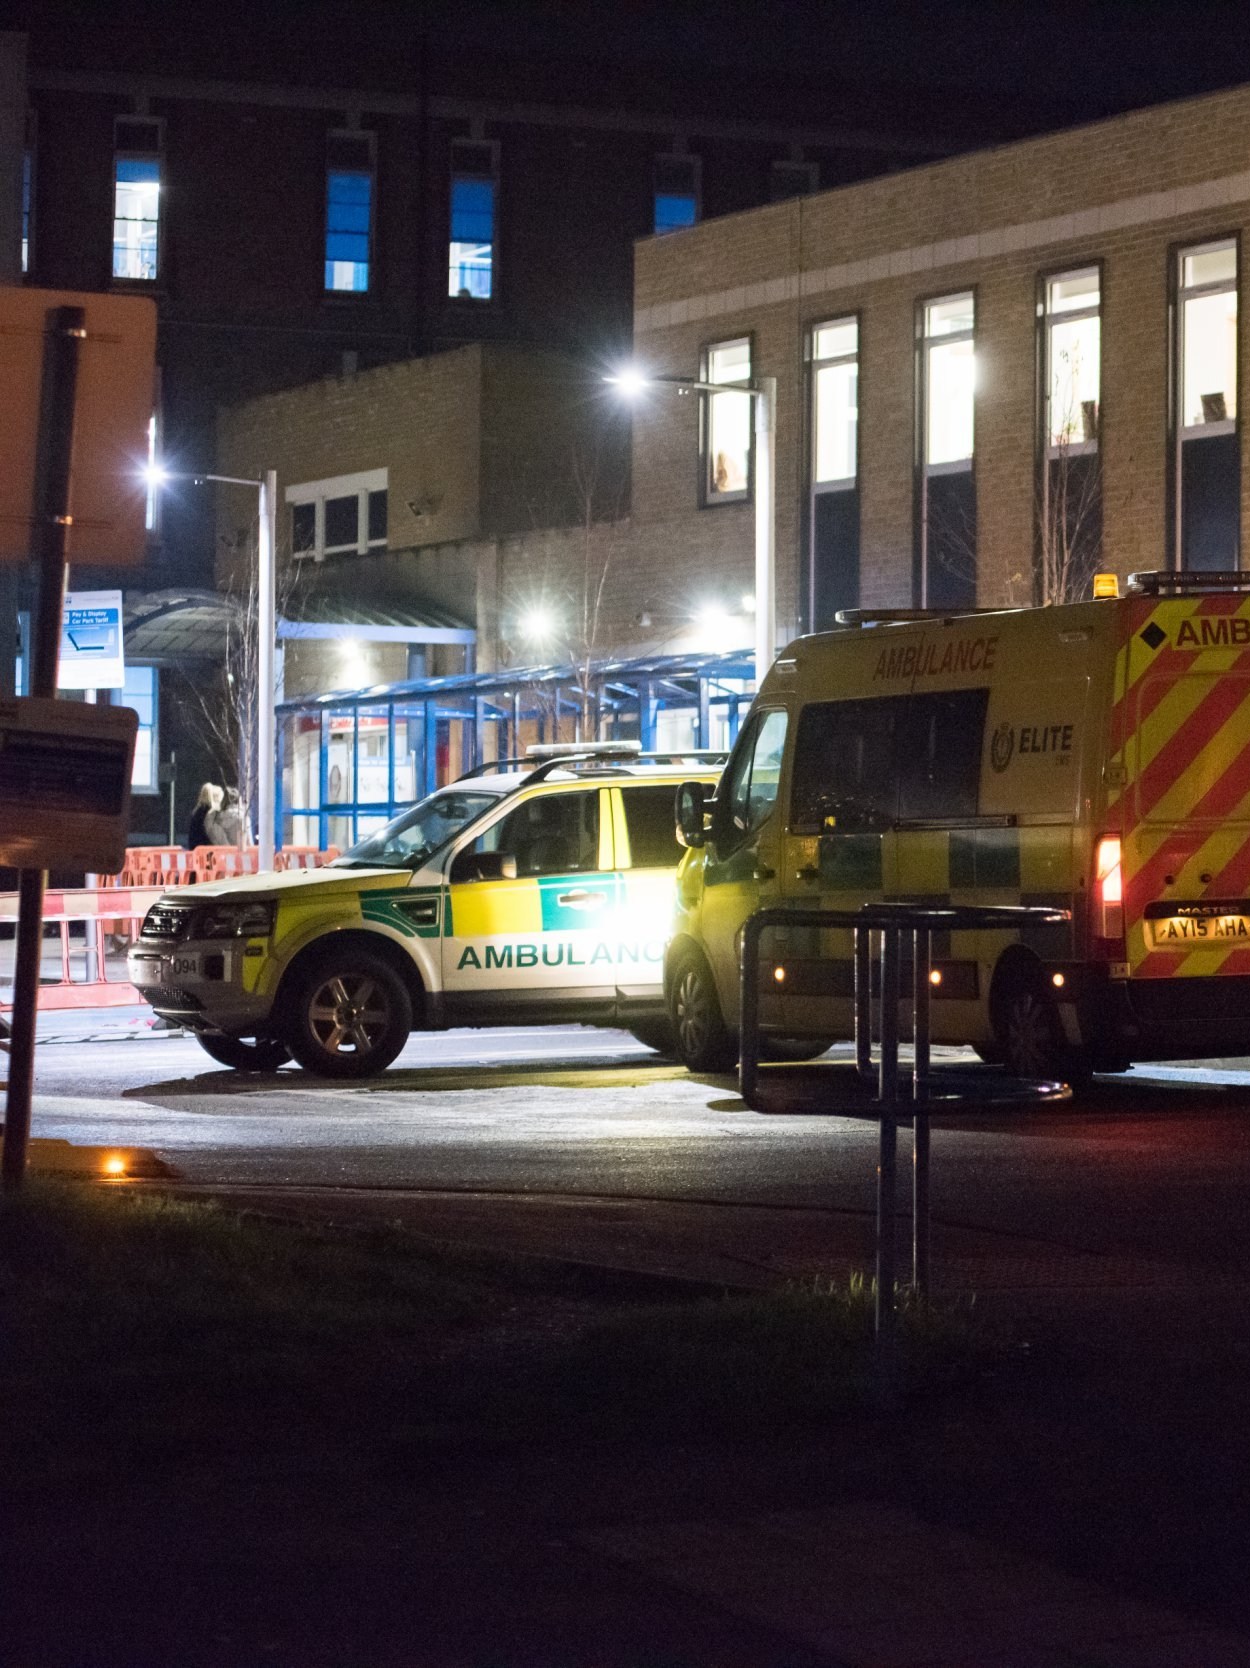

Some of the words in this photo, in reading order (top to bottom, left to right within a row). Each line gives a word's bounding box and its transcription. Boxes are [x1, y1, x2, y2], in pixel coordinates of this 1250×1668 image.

[872, 637, 999, 681] AMBULANCE
[1018, 725, 1074, 754] ELITE
[1177, 906, 1240, 915] MASTER
[1168, 919, 1207, 938] AY15
[1215, 919, 1248, 936] AHA
